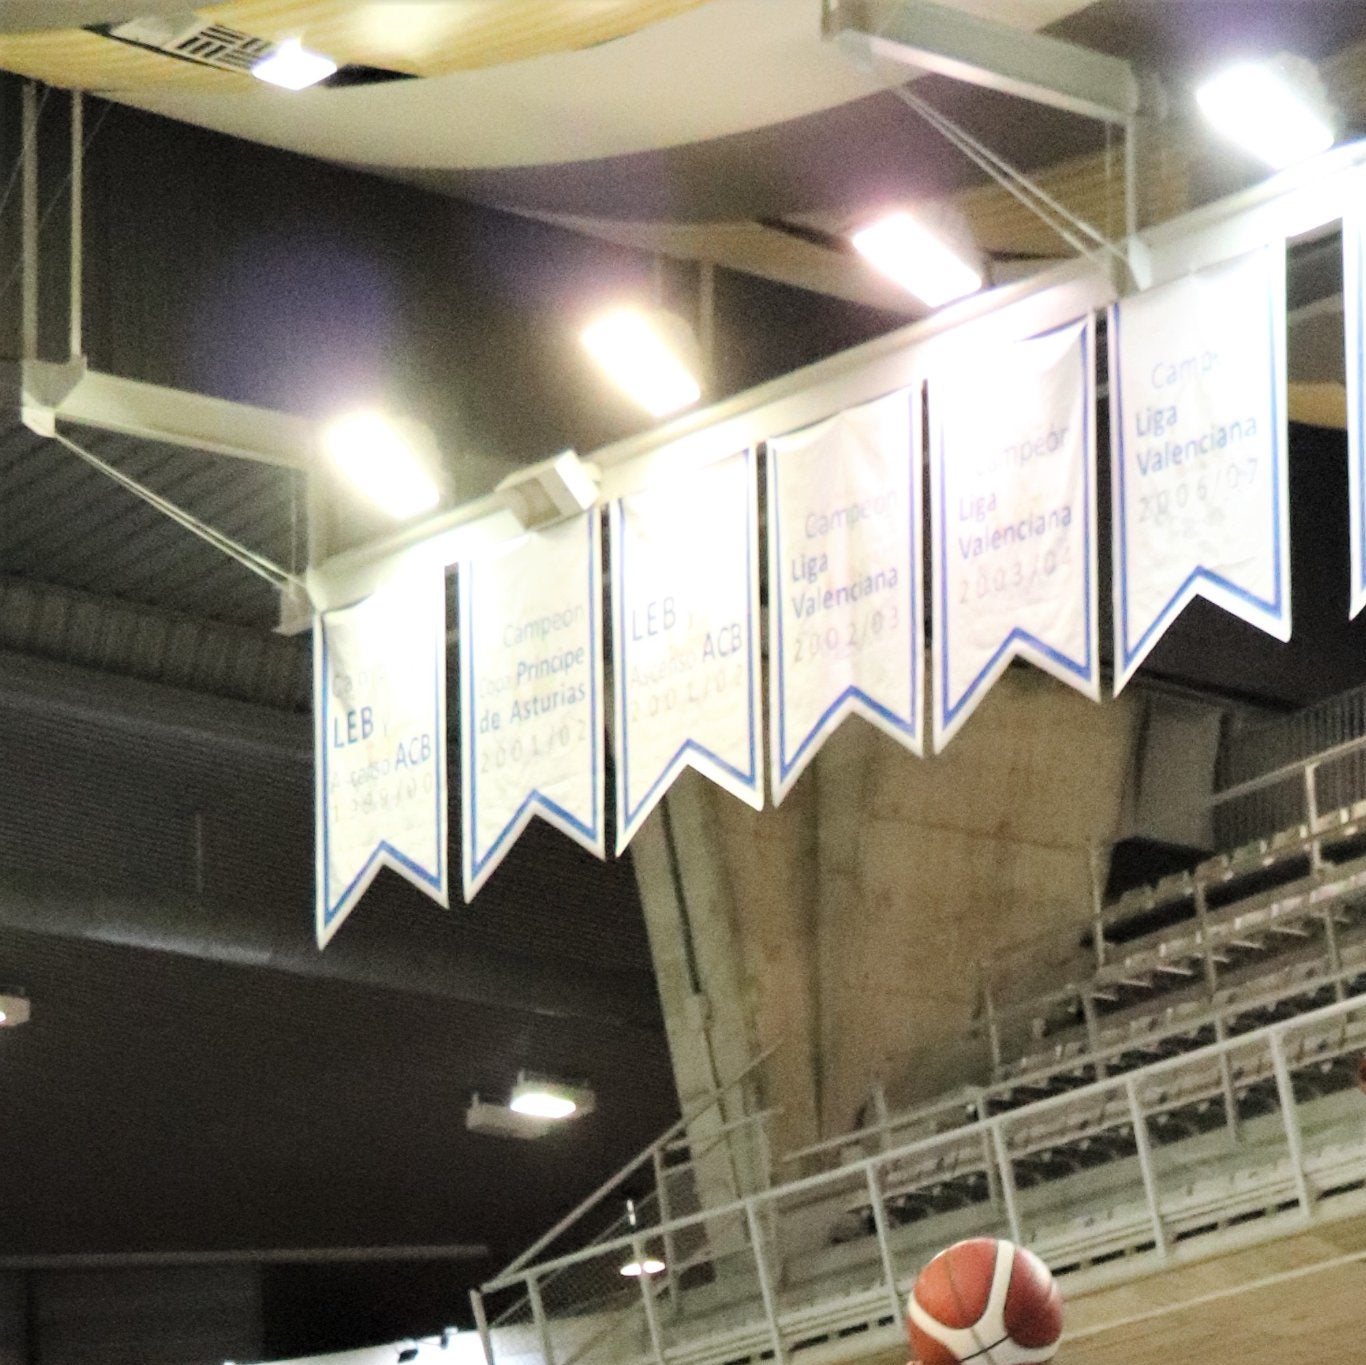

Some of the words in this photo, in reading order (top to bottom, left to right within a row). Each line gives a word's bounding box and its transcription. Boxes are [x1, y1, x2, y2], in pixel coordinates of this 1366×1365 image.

[1134, 405, 1178, 438] Liga
[1134, 416, 1258, 478] Valenciana
[958, 491, 998, 524] Liga
[957, 502, 1074, 561] Valenciana
[791, 552, 829, 585] Liga
[791, 566, 899, 620] Valenciana
[631, 596, 677, 643] LEB
[700, 621, 744, 664] ACB
[333, 705, 375, 750] LEB
[479, 708, 501, 735] de
[509, 682, 587, 725] Asturias
[394, 732, 433, 772] ACB
